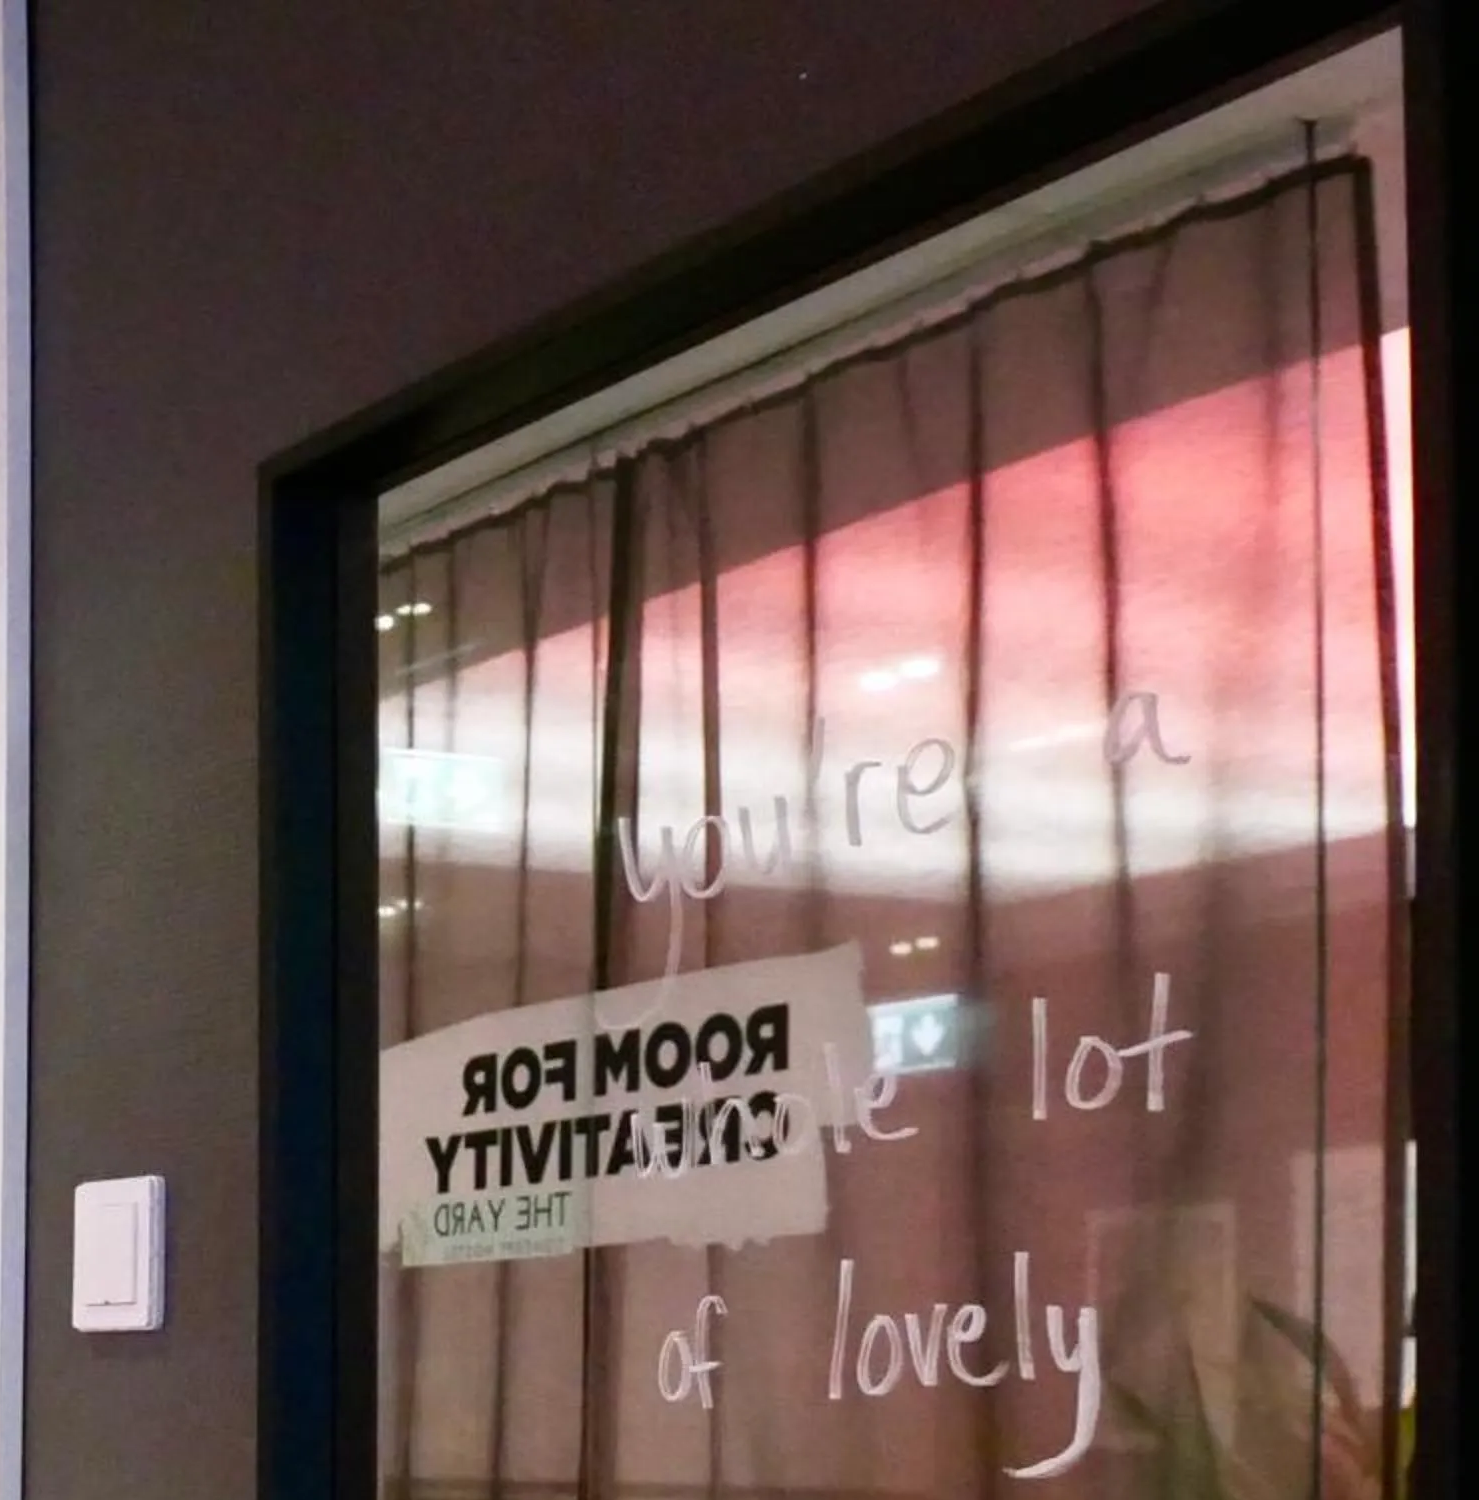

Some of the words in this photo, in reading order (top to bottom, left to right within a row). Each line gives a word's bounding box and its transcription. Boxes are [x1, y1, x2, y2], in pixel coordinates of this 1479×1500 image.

[594, 715, 957, 1029] you're
[1104, 691, 1192, 766] a
[630, 1040, 921, 1178] whole
[1031, 972, 1194, 1121] lot
[657, 1295, 728, 1409] of
[828, 1250, 1101, 1479] lovely
